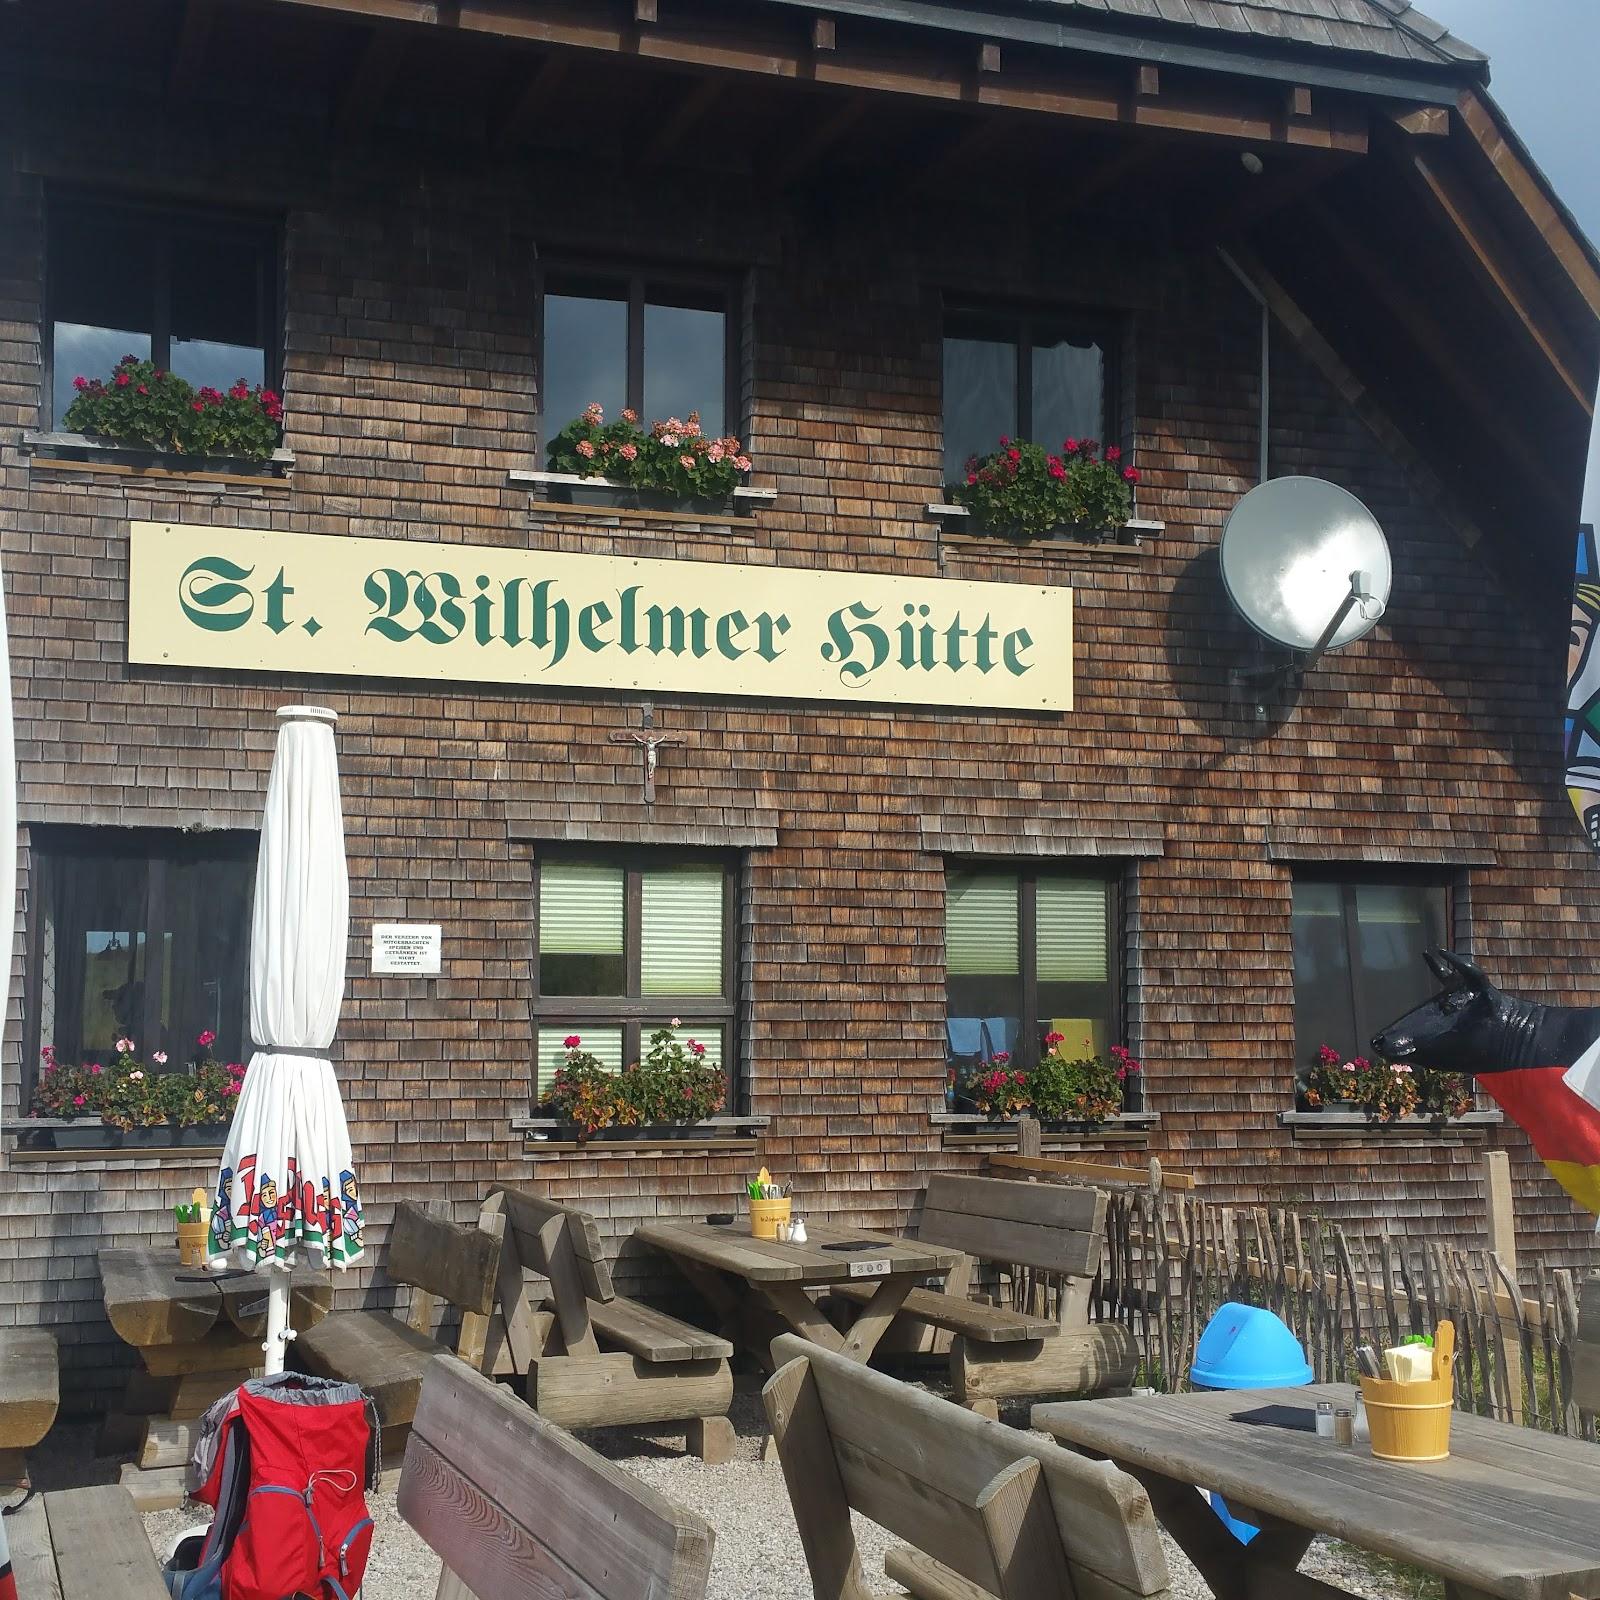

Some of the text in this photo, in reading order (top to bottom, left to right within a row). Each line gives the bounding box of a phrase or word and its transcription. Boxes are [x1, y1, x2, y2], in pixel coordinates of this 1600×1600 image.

[179, 556, 1035, 687] St. Wilhelmer Hütte
